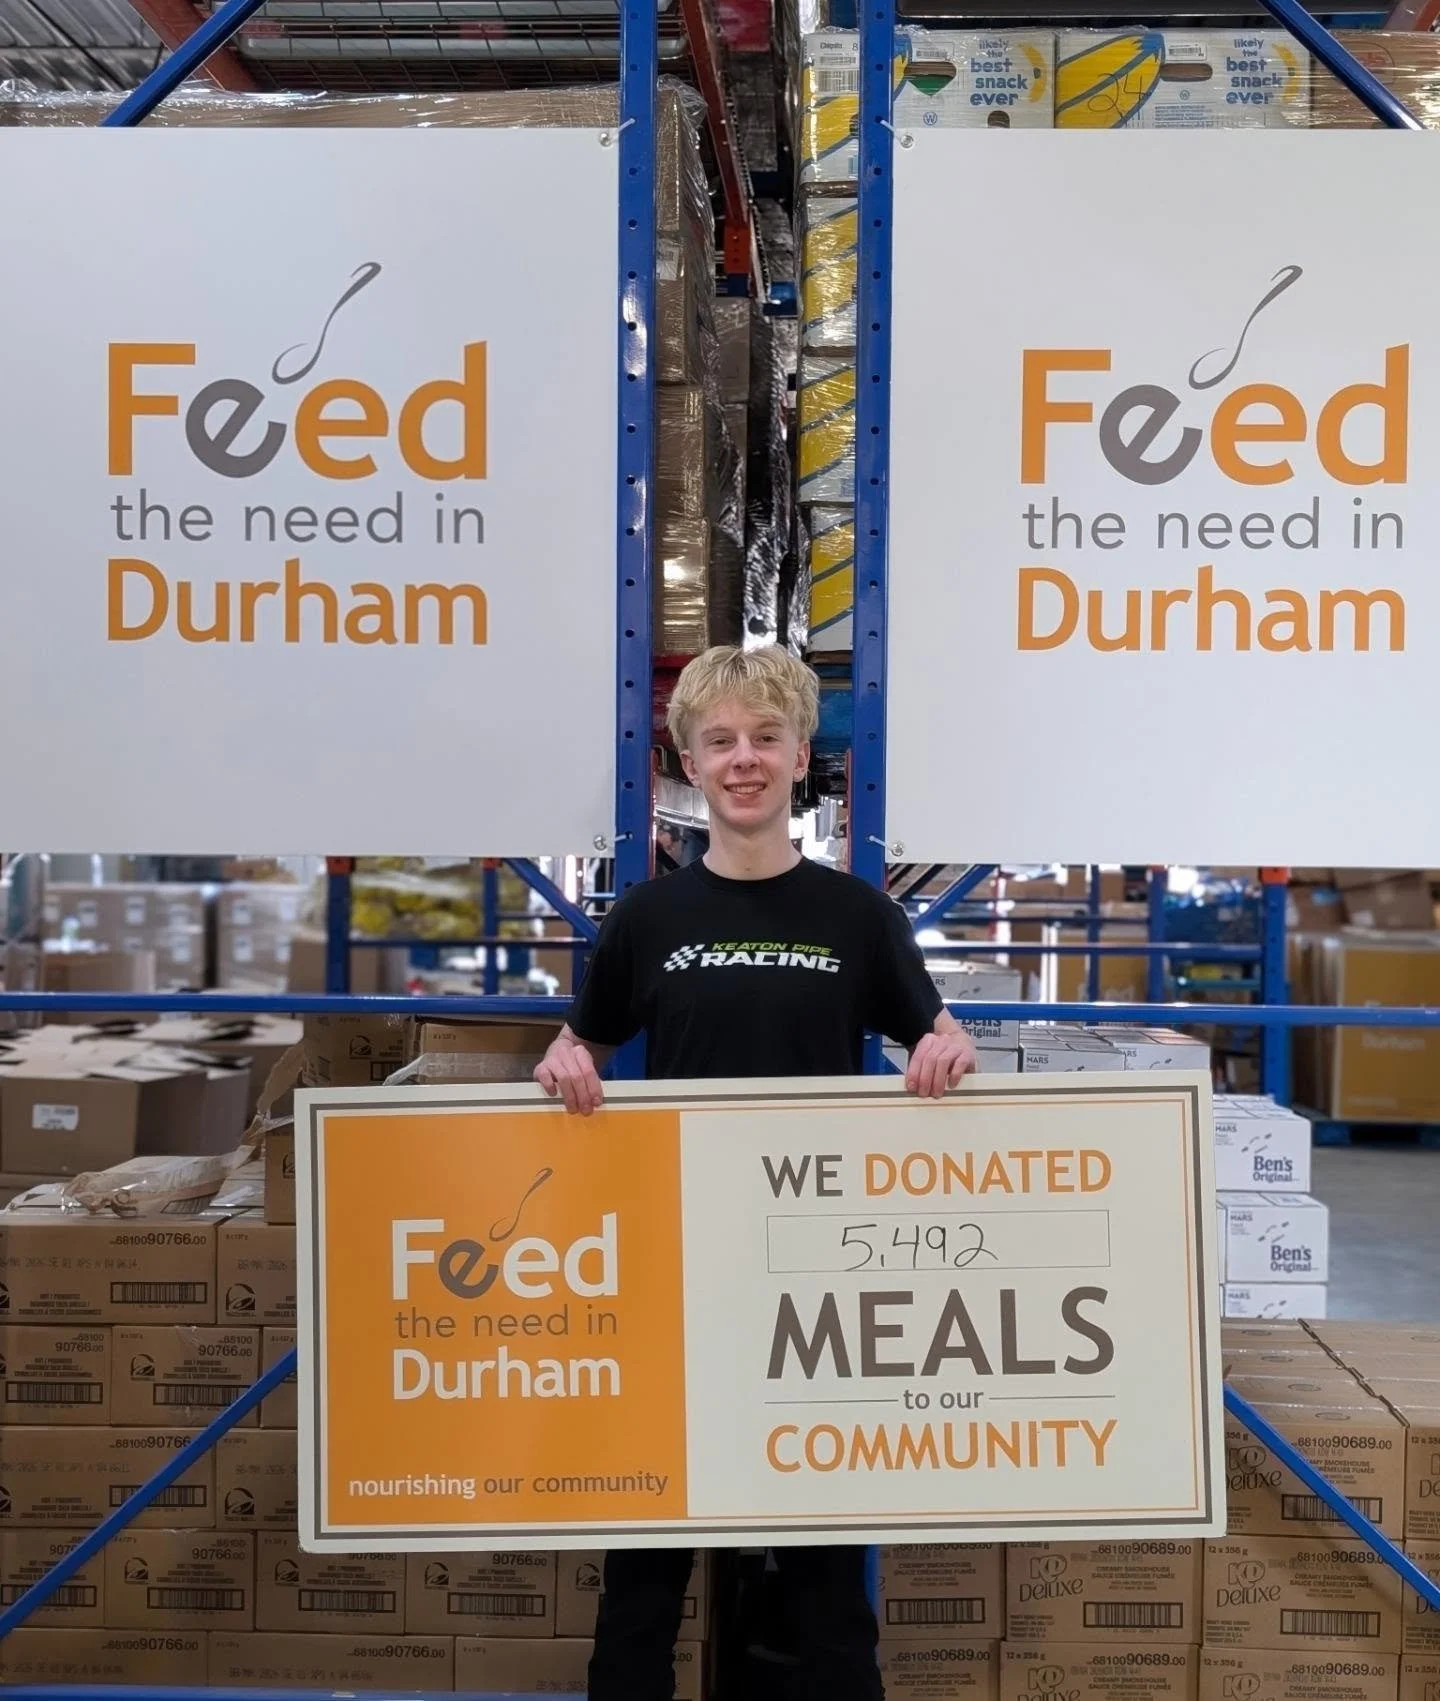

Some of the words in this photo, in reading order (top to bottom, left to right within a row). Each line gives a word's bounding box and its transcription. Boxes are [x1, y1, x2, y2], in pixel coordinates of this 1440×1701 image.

[979, 38, 1010, 50] likely
[986, 50, 1003, 58] the
[1233, 38, 1265, 50] likely
[970, 58, 1013, 73] best
[1226, 57, 1268, 72] best
[975, 74, 1029, 90] snack
[1230, 74, 1284, 88] snack
[969, 93, 1019, 106] ever
[1225, 91, 1274, 105] ever
[108, 340, 487, 480] Feed
[1020, 344, 1409, 485] Feed
[110, 488, 214, 542] the
[244, 491, 404, 543] need
[435, 492, 485, 543] in
[1022, 496, 1127, 550] the
[1157, 496, 1320, 550] need
[1352, 497, 1403, 550] in
[107, 557, 487, 645] Durham
[1017, 564, 1405, 652] Durham
[711, 941, 788, 952] KEATON
[792, 942, 833, 956] PIPE
[699, 950, 841, 974] RACING
[761, 1154, 843, 1198] WE
[865, 1149, 1112, 1197] DONATED
[1253, 1155, 1293, 1172] Ben's
[1252, 1172, 1293, 1183] Original
[392, 1211, 619, 1300] Feed
[1270, 1244, 1312, 1261] Ben's
[1270, 1261, 1312, 1273] Original
[394, 1307, 457, 1339] the
[473, 1304, 569, 1336] need
[586, 1304, 617, 1335] in
[766, 1286, 1115, 1380] MEALS
[392, 1345, 621, 1401] Durham
[903, 1389, 930, 1410] to
[940, 1391, 984, 1410] our
[766, 1419, 1118, 1473] COMMUNITY
[349, 1473, 476, 1499] nourishing
[483, 1477, 525, 1494] our
[531, 1470, 669, 1497] community
[1019, 1577, 1084, 1603] Deluxe
[1216, 1585, 1282, 1608] Deluxe
